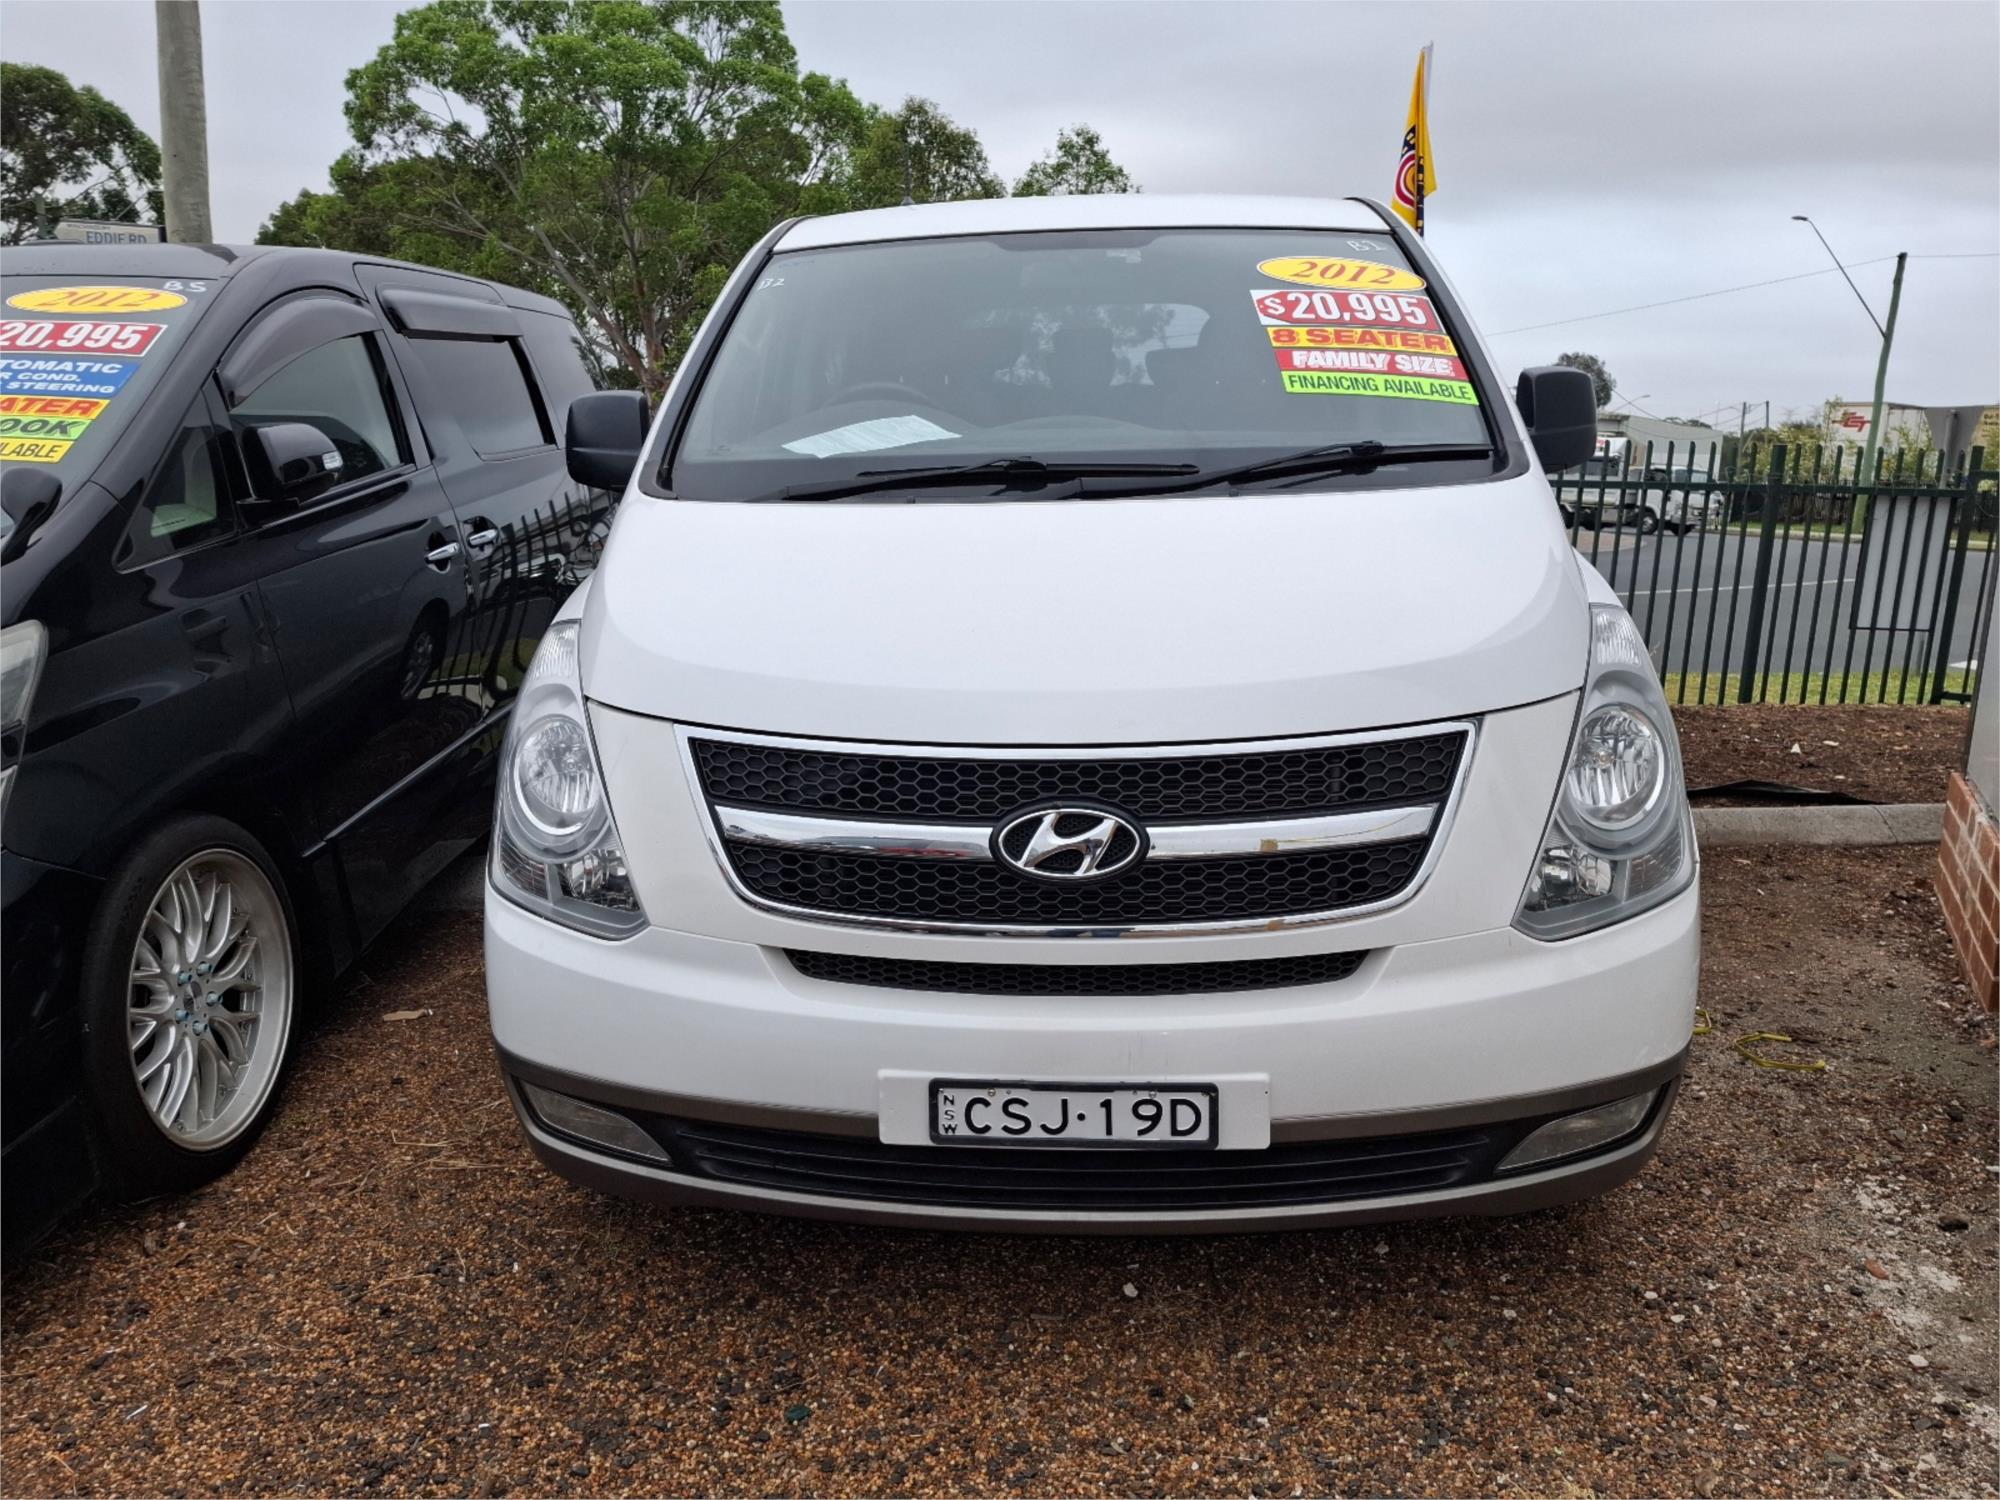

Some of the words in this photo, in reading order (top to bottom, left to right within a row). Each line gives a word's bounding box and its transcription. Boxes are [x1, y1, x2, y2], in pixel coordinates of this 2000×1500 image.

[1290, 261, 1396, 285] 2012
[35, 291, 160, 307] 2012
[1272, 328, 1298, 344] 8
[1305, 329, 1449, 351] SEATER
[1291, 350, 1389, 371] FAMILY
[1394, 356, 1455, 377] SIZE
[6, 381, 116, 394] STEERING
[1288, 374, 1379, 393] FINANCING
[1384, 381, 1472, 401] AVAILABLE
